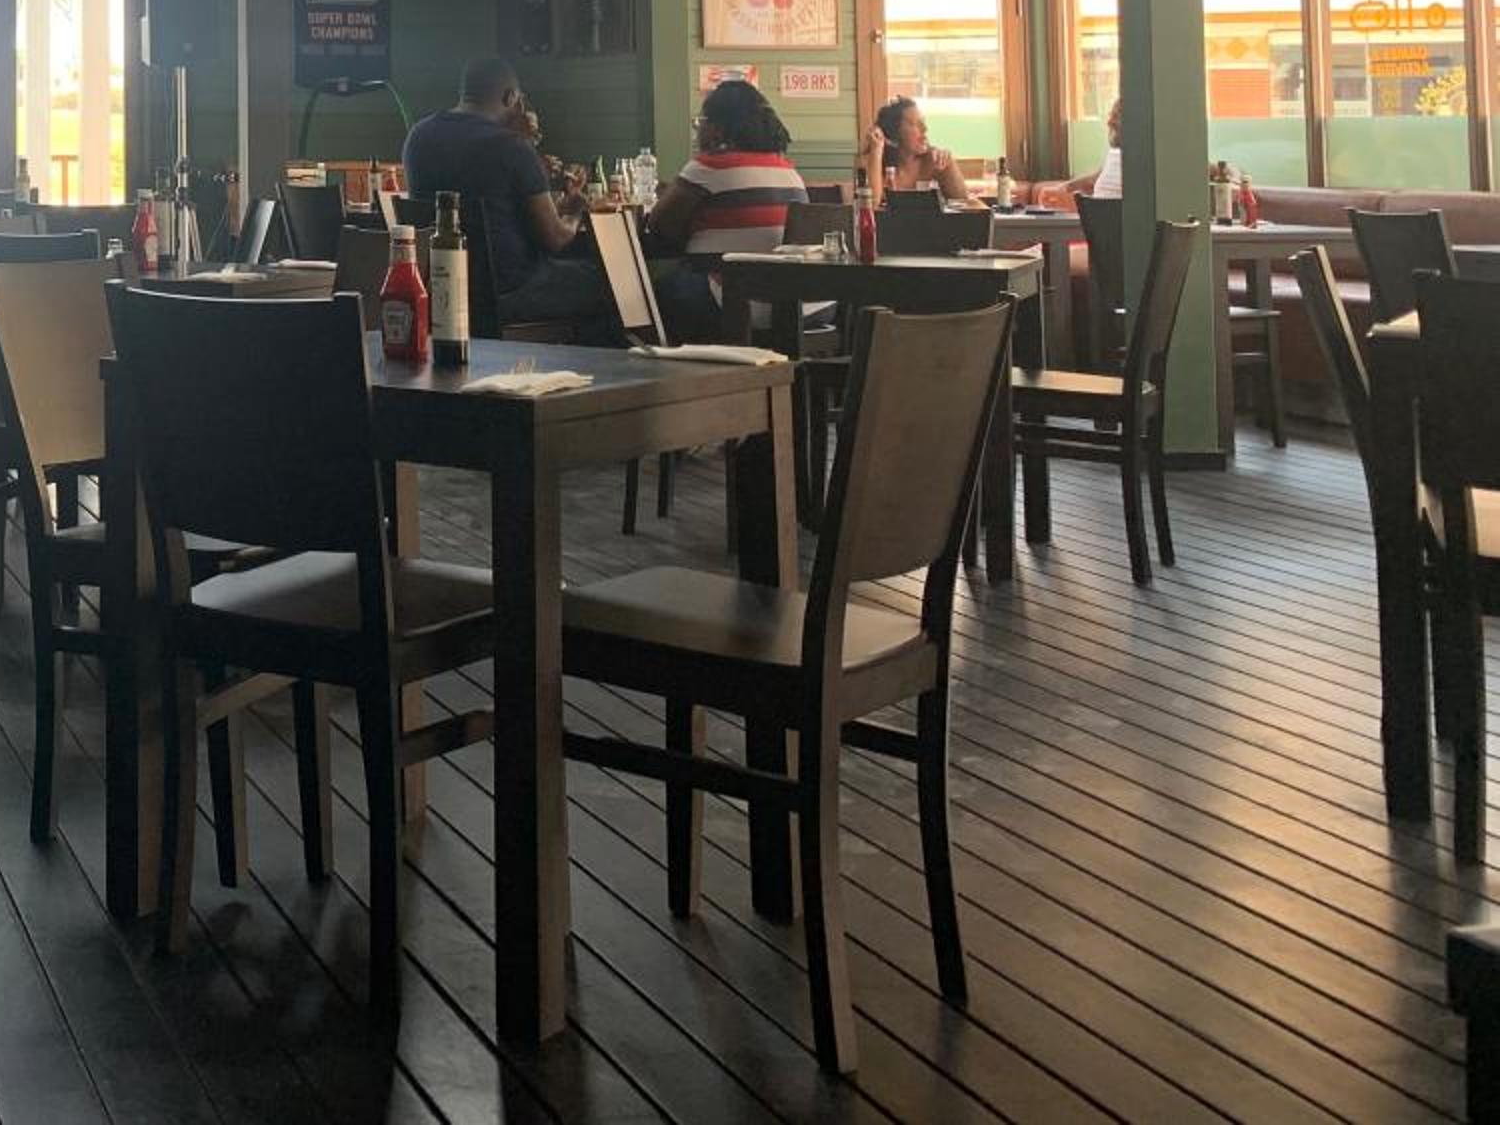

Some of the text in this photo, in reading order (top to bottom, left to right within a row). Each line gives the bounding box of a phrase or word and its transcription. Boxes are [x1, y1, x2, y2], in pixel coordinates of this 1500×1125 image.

[307, 11, 377, 26] SUPER BOWL
[311, 26, 375, 41] CHAMPIONS
